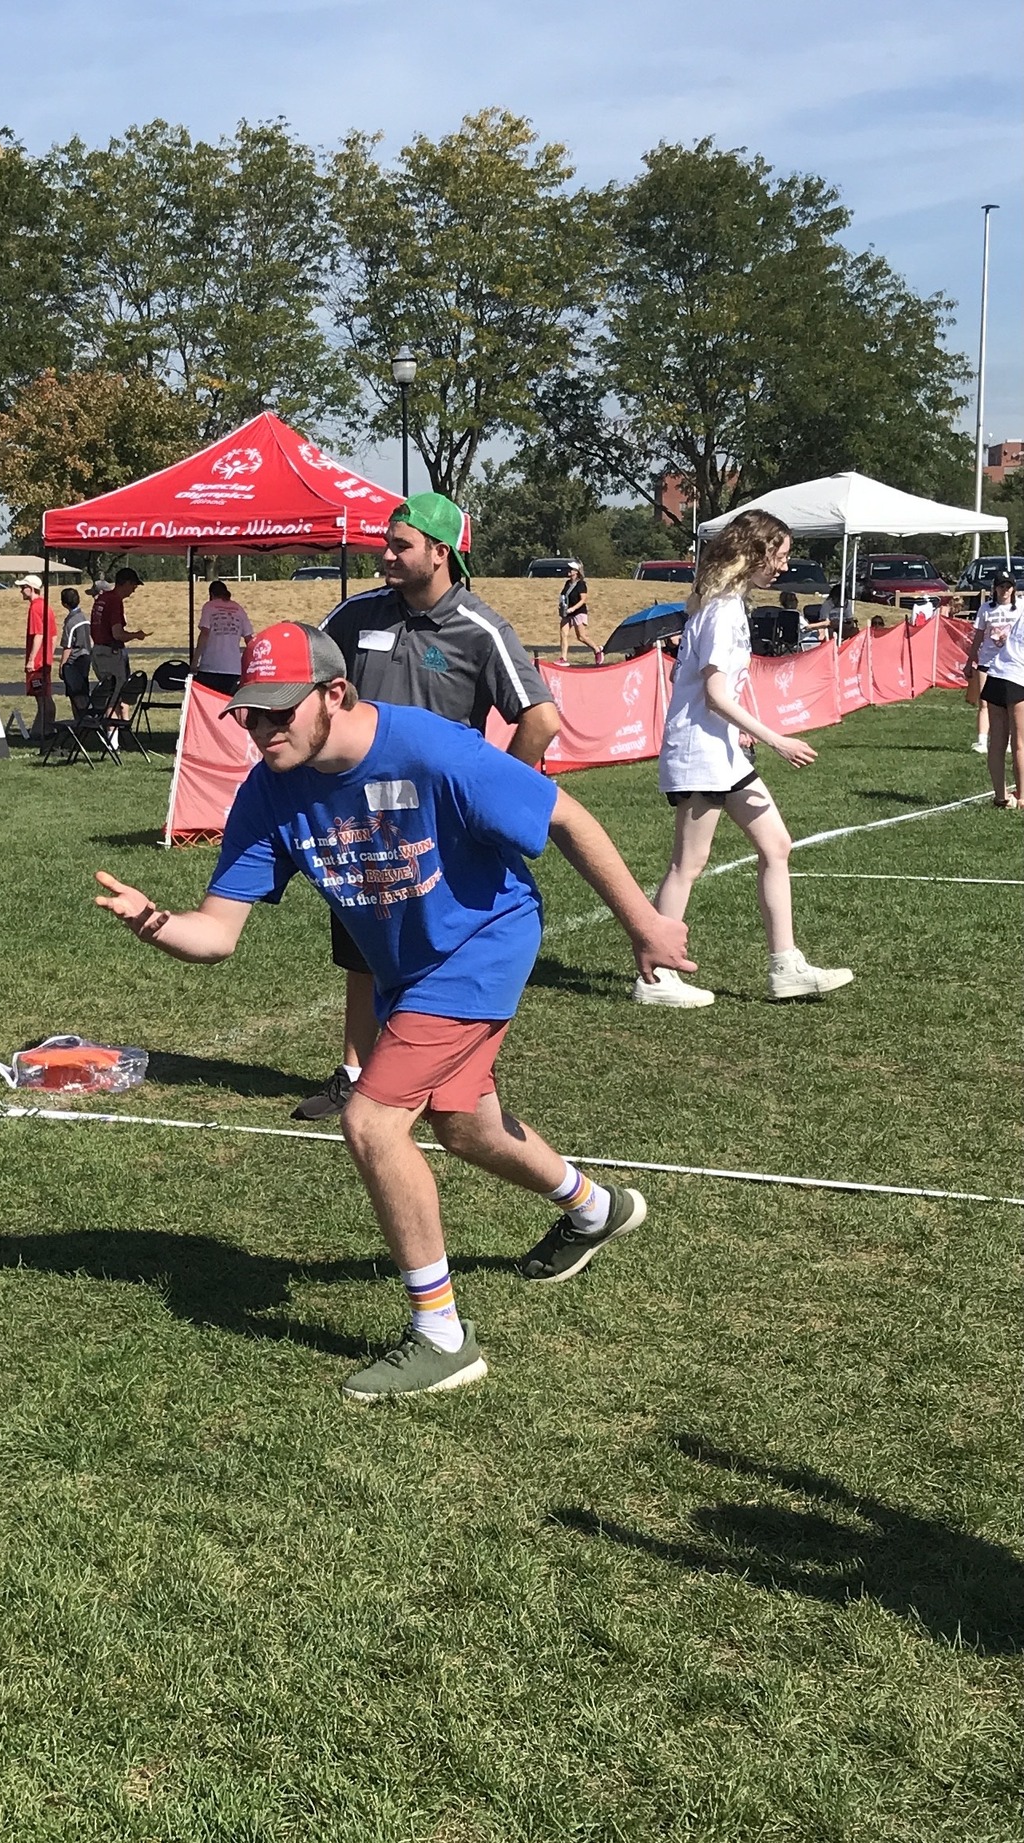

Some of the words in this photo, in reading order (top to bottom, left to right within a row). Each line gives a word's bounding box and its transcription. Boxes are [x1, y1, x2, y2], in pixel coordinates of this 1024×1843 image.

[189, 483, 255, 492] Special
[174, 491, 255, 500] Olympics
[294, 836, 316, 850] Let
[318, 836, 338, 847] me
[311, 855, 337, 868] but
[337, 853, 349, 865] if
[349, 851, 357, 863] I
[359, 850, 398, 862] cannot
[322, 875, 345, 887] me
[346, 872, 364, 884] be
[365, 865, 413, 883] BRAVE
[340, 895, 355, 907] in
[356, 893, 377, 906] the
